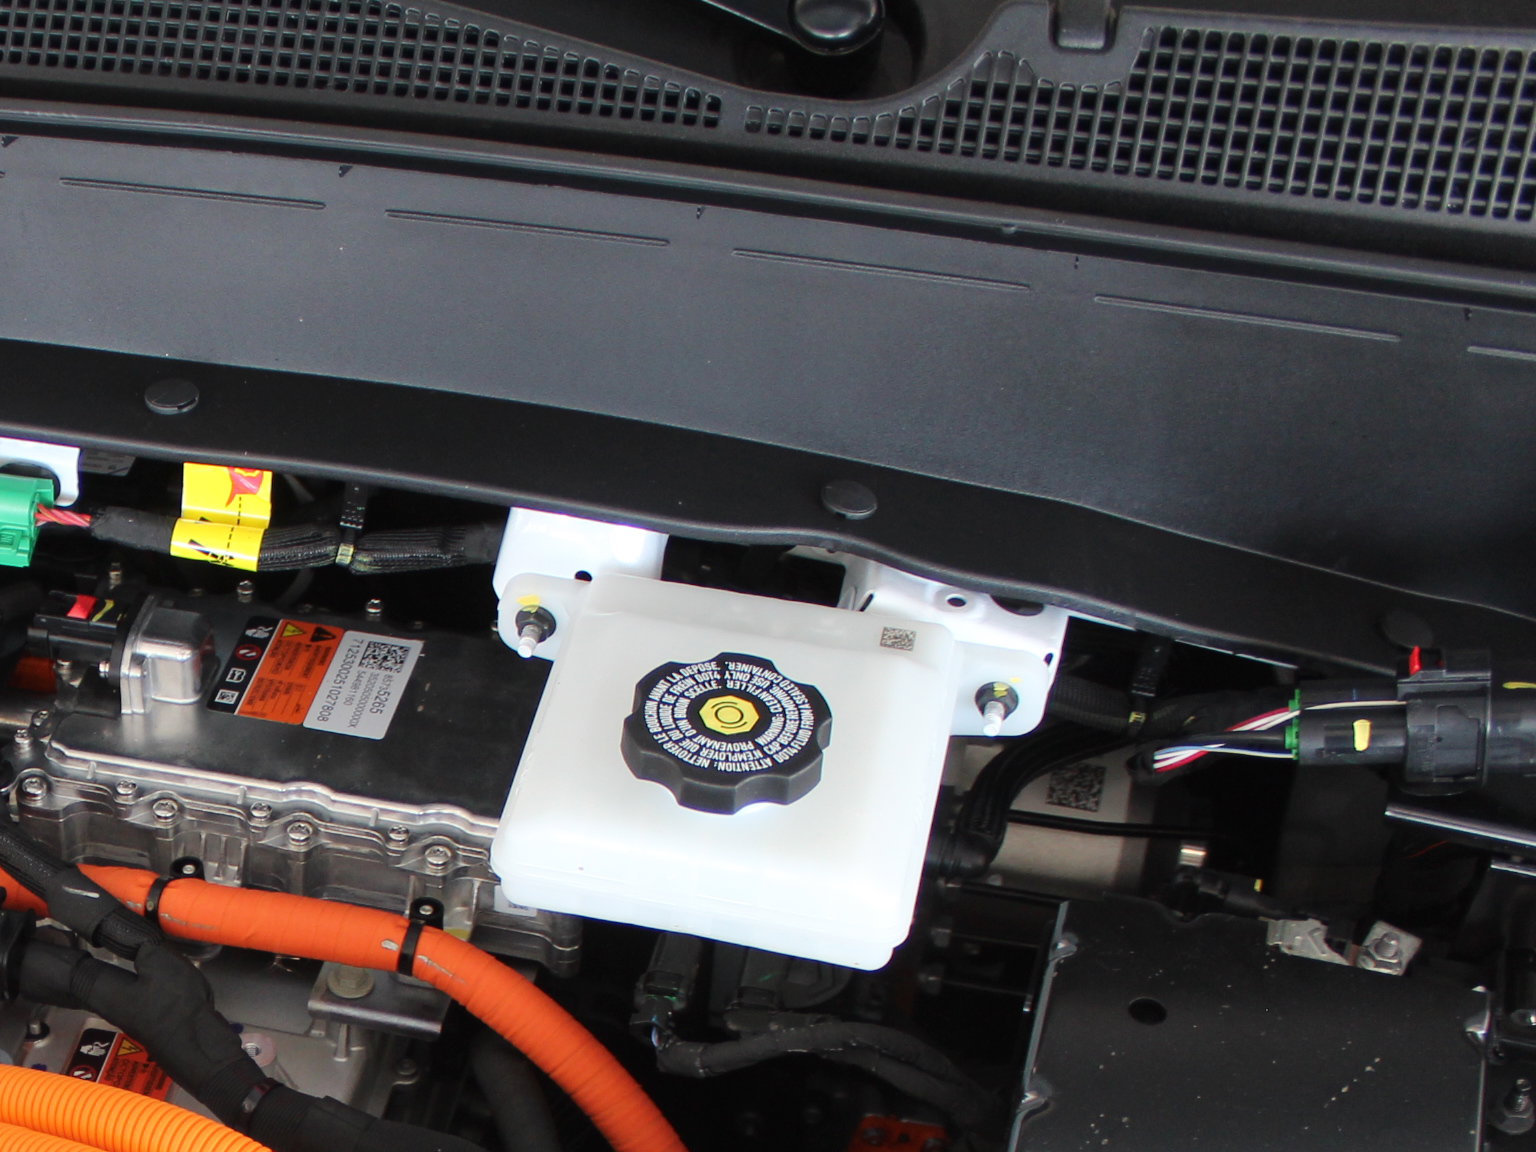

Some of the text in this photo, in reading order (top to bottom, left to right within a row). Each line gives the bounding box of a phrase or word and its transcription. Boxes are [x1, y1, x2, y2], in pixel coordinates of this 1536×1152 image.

[666, 671, 683, 682] LA
[724, 671, 751, 681] ONLY
[725, 662, 785, 682] CONTAINER.
[750, 675, 772, 687] USE
[647, 680, 672, 699] AVANT
[778, 679, 807, 703] SEALED
[643, 701, 661, 732] BOUCHON
[658, 670, 763, 761] N'EMPLOYER QUE DU LIQUIDE DE FREIN DOT4
[672, 697, 691, 717] BIDON
[726, 681, 784, 745] WARNING: CLEAN FILLER
[799, 709, 814, 728] FROM
[654, 733, 668, 742] LE
[775, 721, 799, 744] BEFORE
[789, 729, 812, 748] FLUID
[689, 734, 755, 751] PROVENANT
[762, 741, 784, 754] CAP
[661, 742, 709, 766] NETTOYER
[712, 756, 773, 771] ATTENTION:
[771, 746, 798, 762] DOT4
